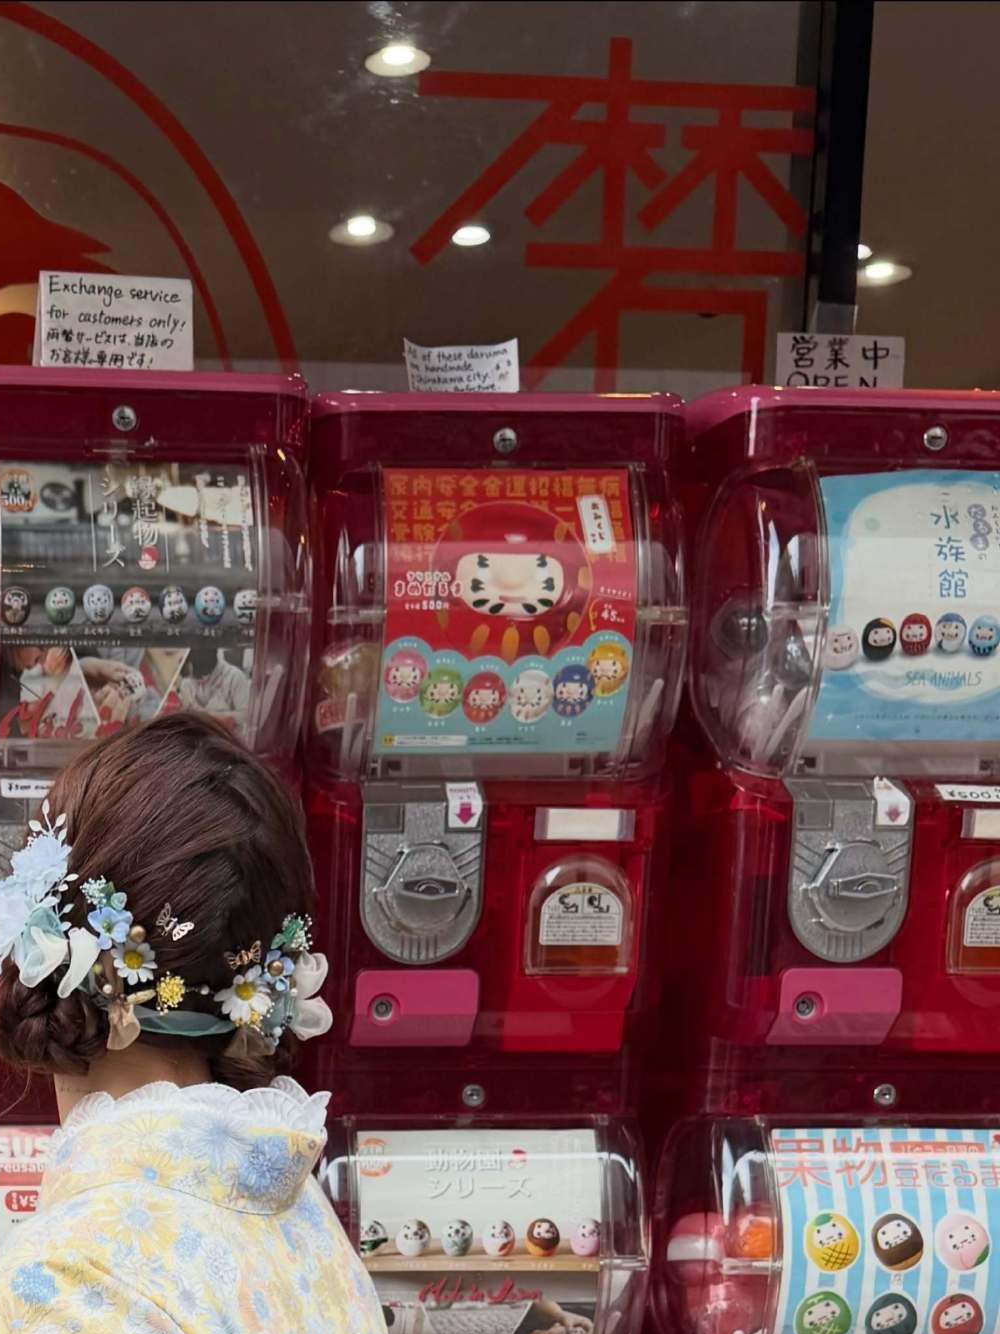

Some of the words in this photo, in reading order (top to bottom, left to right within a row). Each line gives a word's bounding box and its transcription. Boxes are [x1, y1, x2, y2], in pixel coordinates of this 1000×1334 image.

[49, 275, 123, 307] Exchange
[129, 286, 181, 303] service
[47, 305, 69, 319] for
[437, 352, 463, 362] these
[791, 335, 890, 370] 営業中
[425, 361, 473, 372] handmade
[930, 505, 968, 598] 水族館
[429, 1175, 533, 1200] シリーズ
